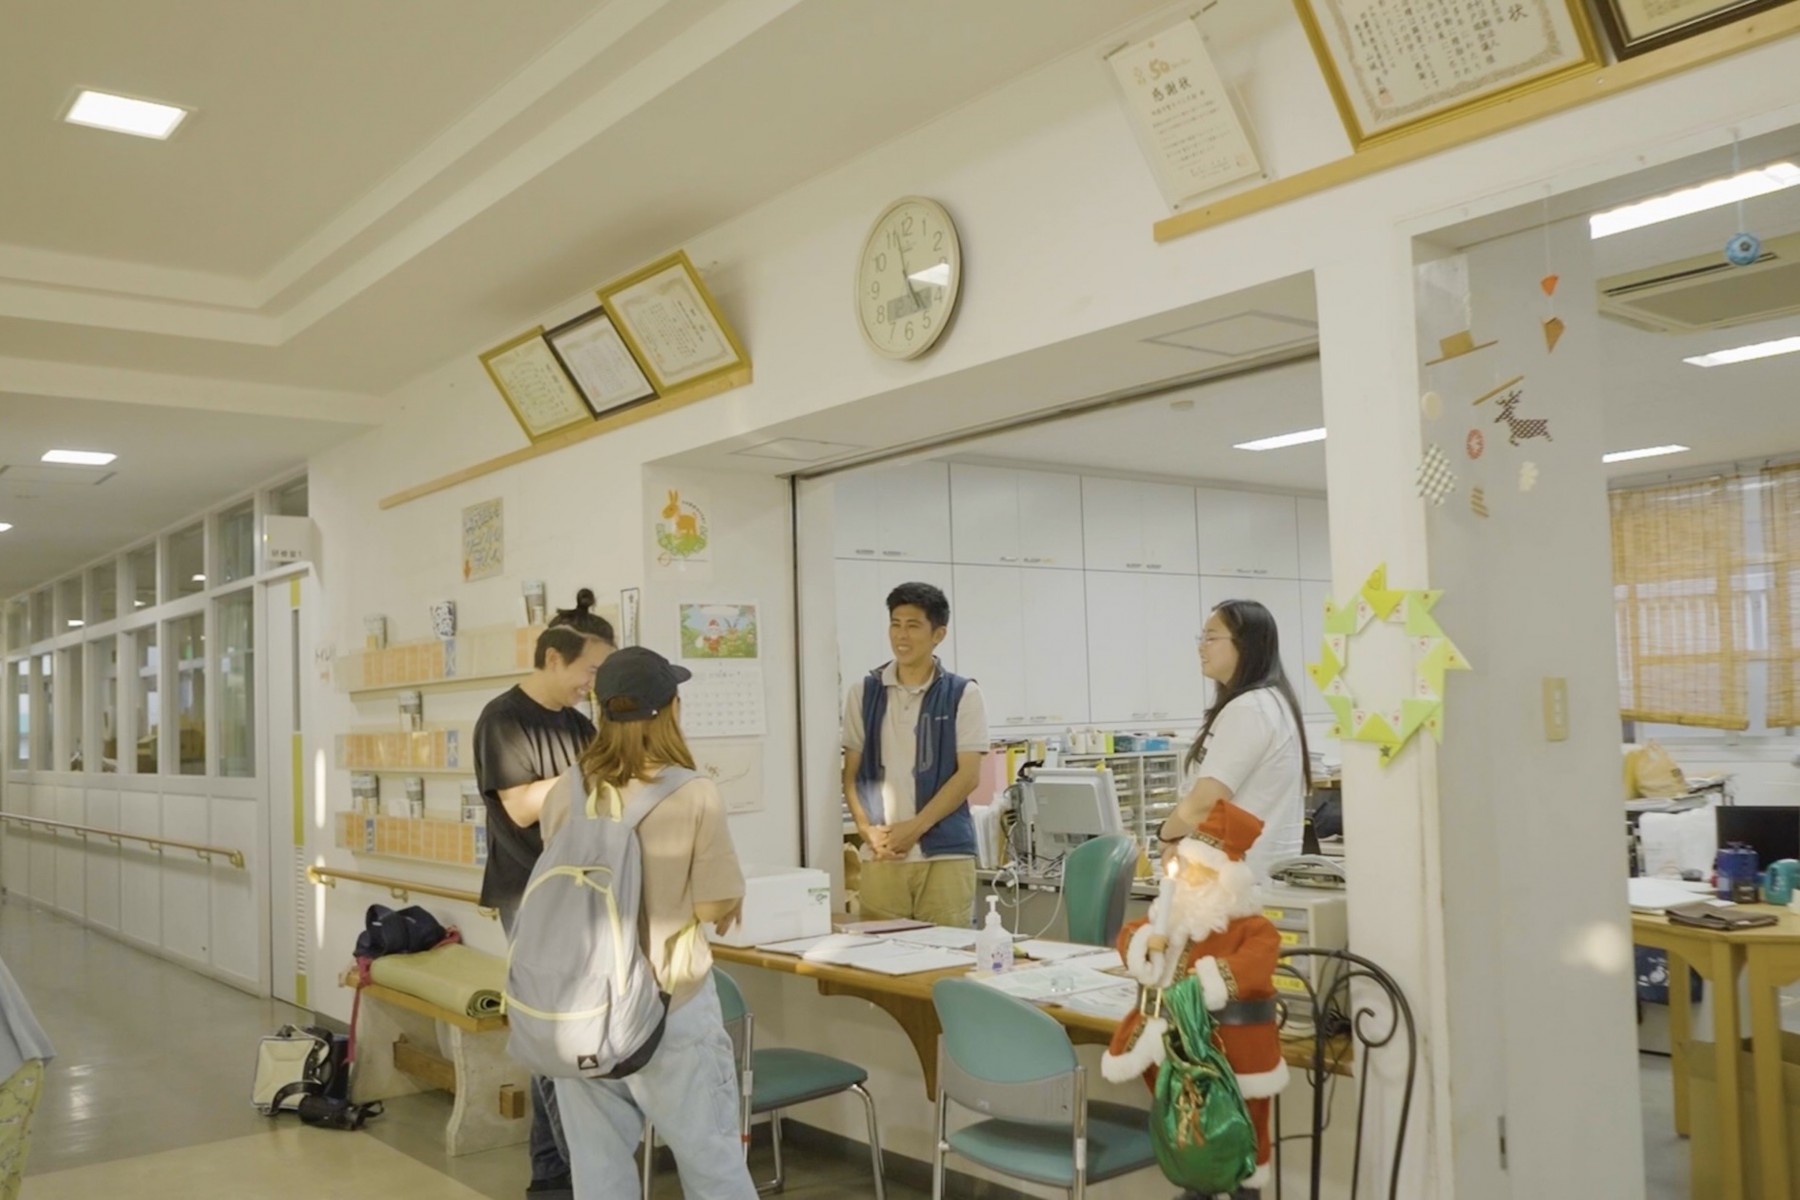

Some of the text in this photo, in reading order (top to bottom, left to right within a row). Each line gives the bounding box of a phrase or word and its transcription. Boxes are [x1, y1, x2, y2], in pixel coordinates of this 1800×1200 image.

[1151, 76, 1192, 102] 感謝状
[901, 216, 913, 237] 12
[922, 218, 927, 237] 1
[886, 229, 899, 250] 11
[933, 231, 943, 252] 2
[874, 252, 887, 272] 10
[871, 281, 880, 300] 9
[934, 286, 943, 304] 4
[876, 305, 886, 324] 8
[922, 310, 932, 330] 5
[889, 322, 896, 341] 7
[905, 321, 914, 341] 6
